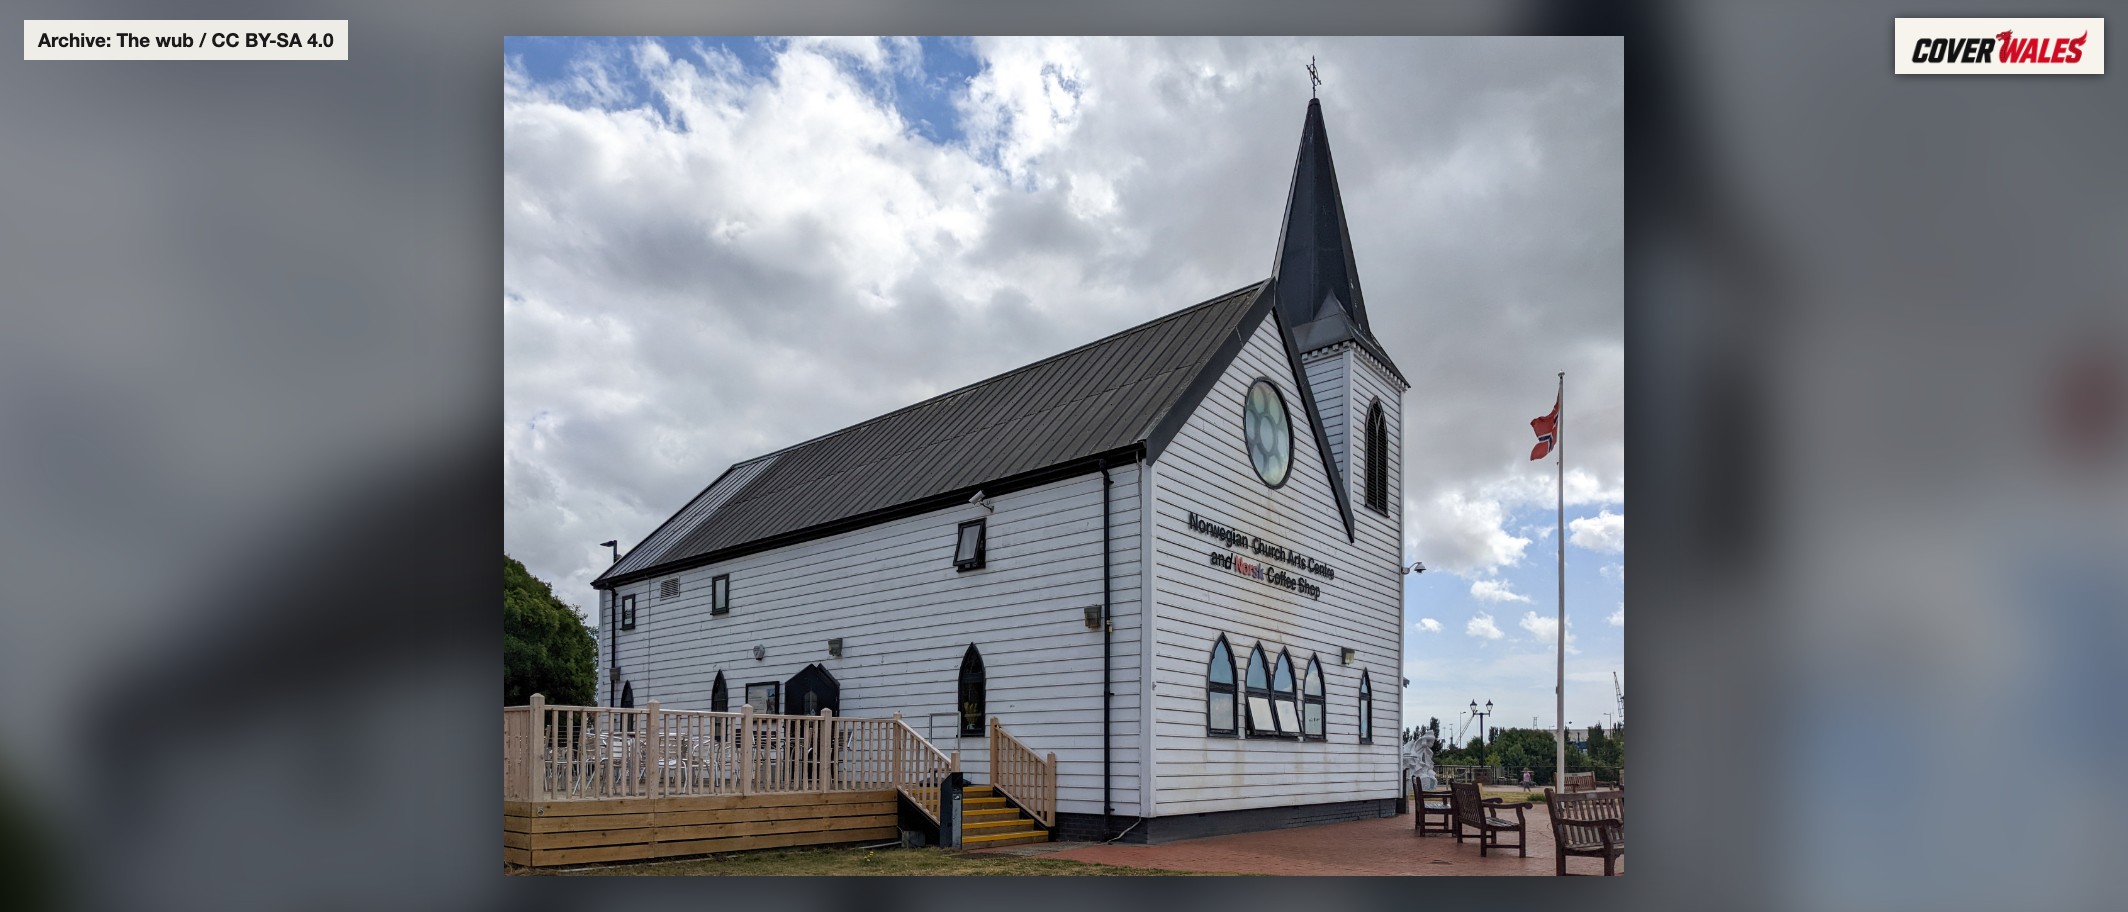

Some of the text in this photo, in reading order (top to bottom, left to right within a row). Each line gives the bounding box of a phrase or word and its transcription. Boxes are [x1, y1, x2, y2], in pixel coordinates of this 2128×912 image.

[1188, 511, 1335, 580] Norwegian Church Arts Centre
[1210, 551, 1321, 600] and Norsk Coffee Shop
